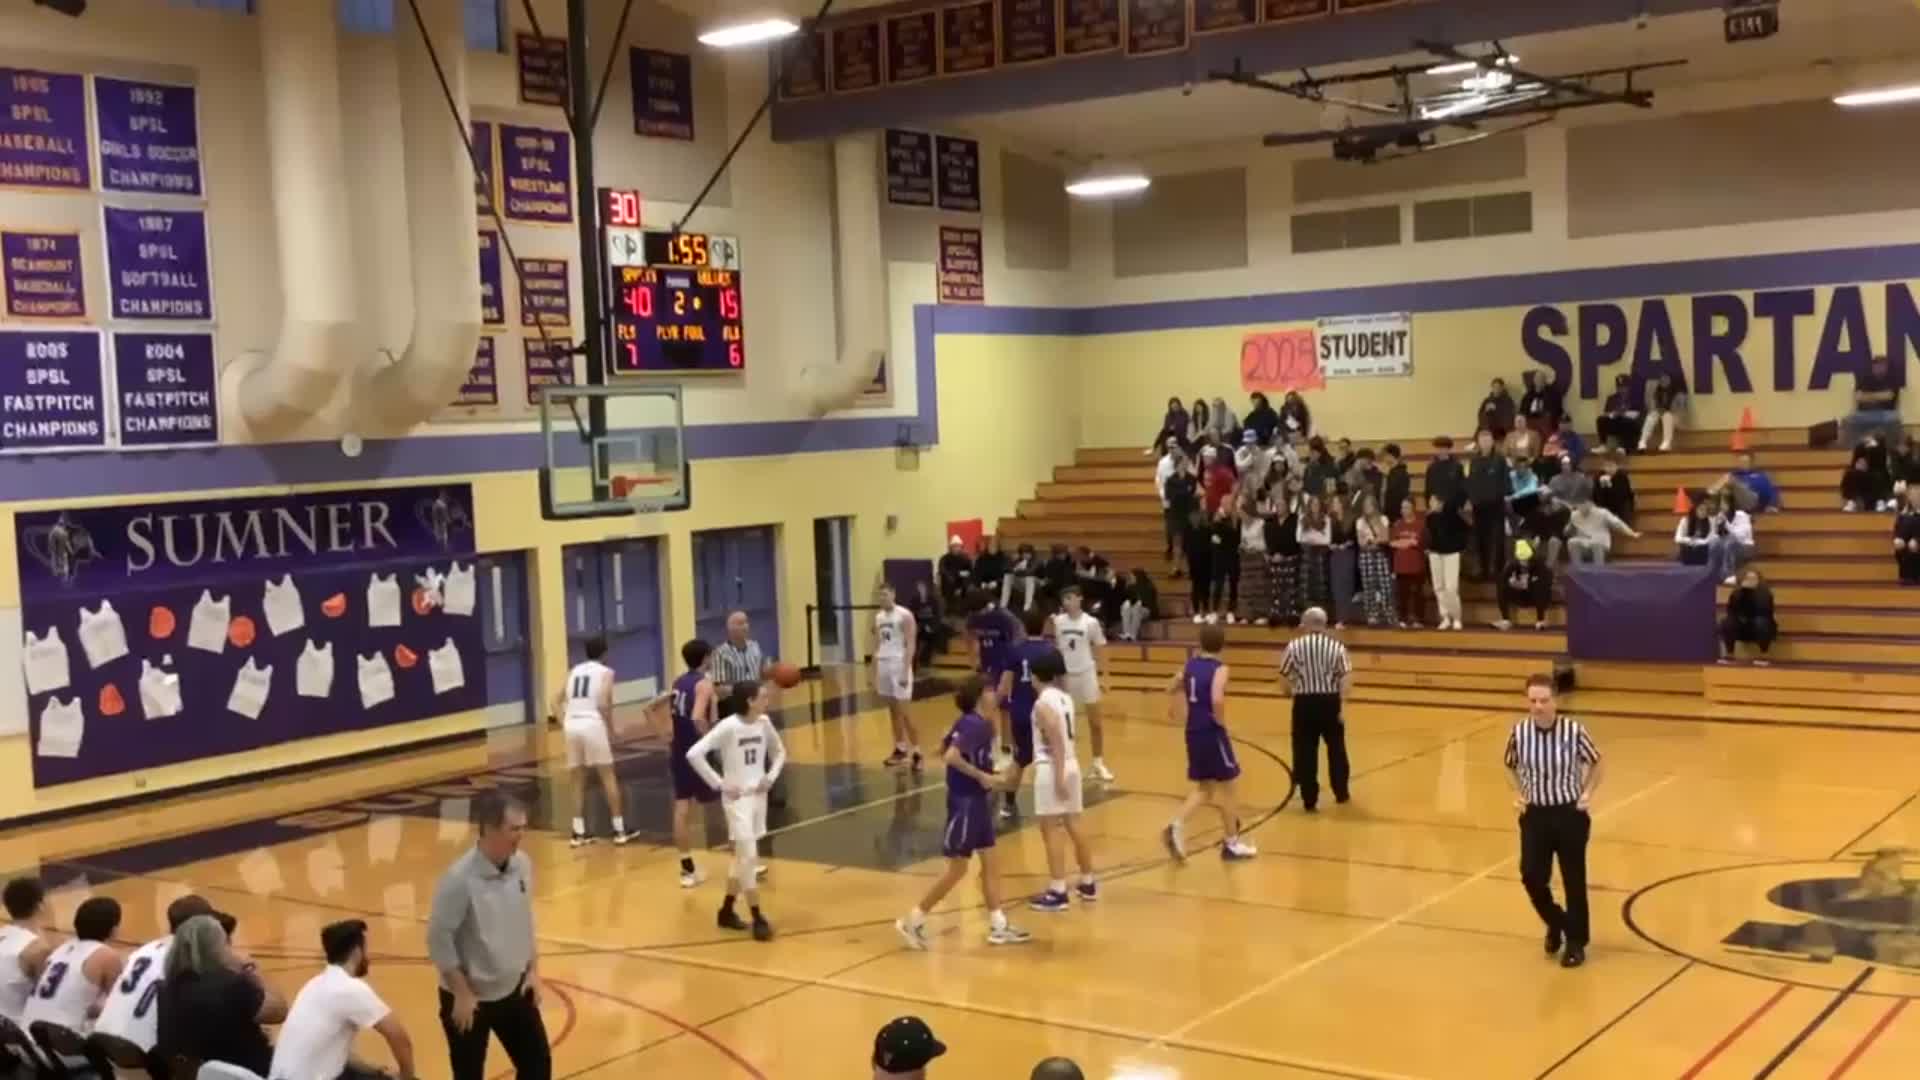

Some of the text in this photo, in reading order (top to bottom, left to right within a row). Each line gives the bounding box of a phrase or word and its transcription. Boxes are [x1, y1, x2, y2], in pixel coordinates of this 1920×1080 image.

[0, 133, 75, 154] ASEBALL
[0, 163, 81, 183] HAMPIONS
[610, 191, 638, 224] 30
[121, 270, 198, 289] SOFTBALL
[120, 298, 204, 315] CHAMPIONS
[624, 286, 653, 317] 40
[674, 290, 685, 315] 2
[720, 288, 738, 319] 15
[626, 343, 637, 366] 7
[729, 343, 741, 366] 6
[1320, 330, 1408, 361] STUDENT
[26, 368, 70, 385] SPSL
[146, 367, 186, 383] SPSL
[4, 395, 95, 411] FASTPITCH
[124, 391, 210, 408] FASTPITCH
[3, 420, 99, 438] CHAMPIONS
[125, 414, 212, 432] CHAMPIONS
[126, 500, 398, 577] SUMNER
[573, 675, 590, 698] 11
[1189, 677, 1198, 702] 1
